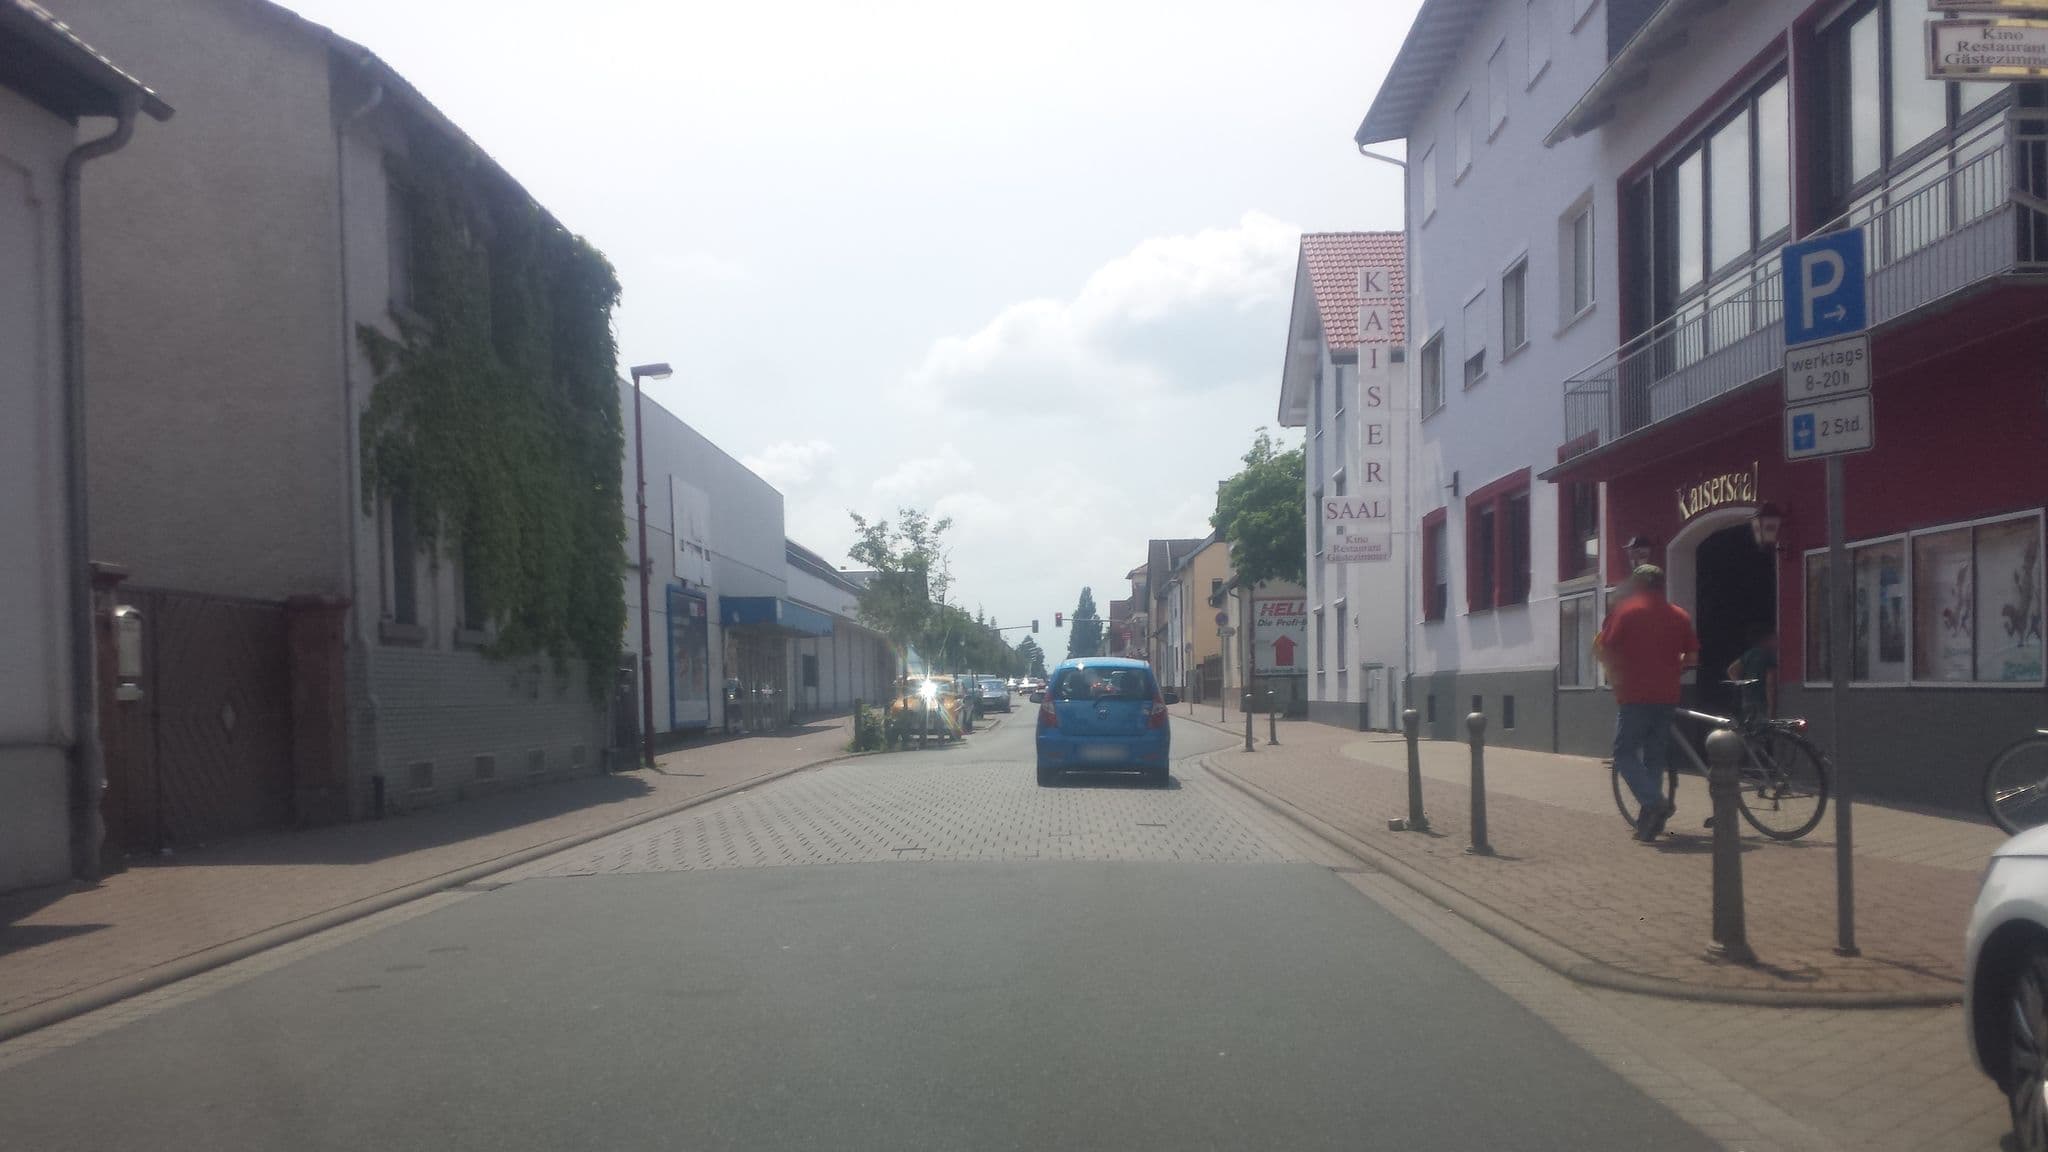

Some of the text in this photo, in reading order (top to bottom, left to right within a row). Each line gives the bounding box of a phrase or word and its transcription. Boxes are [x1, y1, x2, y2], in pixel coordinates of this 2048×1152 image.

[1983, 28, 2024, 40] Kino
[1957, 41, 2046, 54] Restaurant
[1801, 249, 1845, 329] P
[1791, 348, 1864, 372] werktags
[1363, 271, 1384, 483] KAISER
[1821, 416, 1864, 437] 2 Std.
[1675, 461, 1760, 520] Kaisersaal
[1327, 501, 1386, 520] SAAL
[1333, 544, 1382, 553] Restaurant
[1345, 535, 1369, 544] Kino
[1257, 618, 1273, 627] Die
